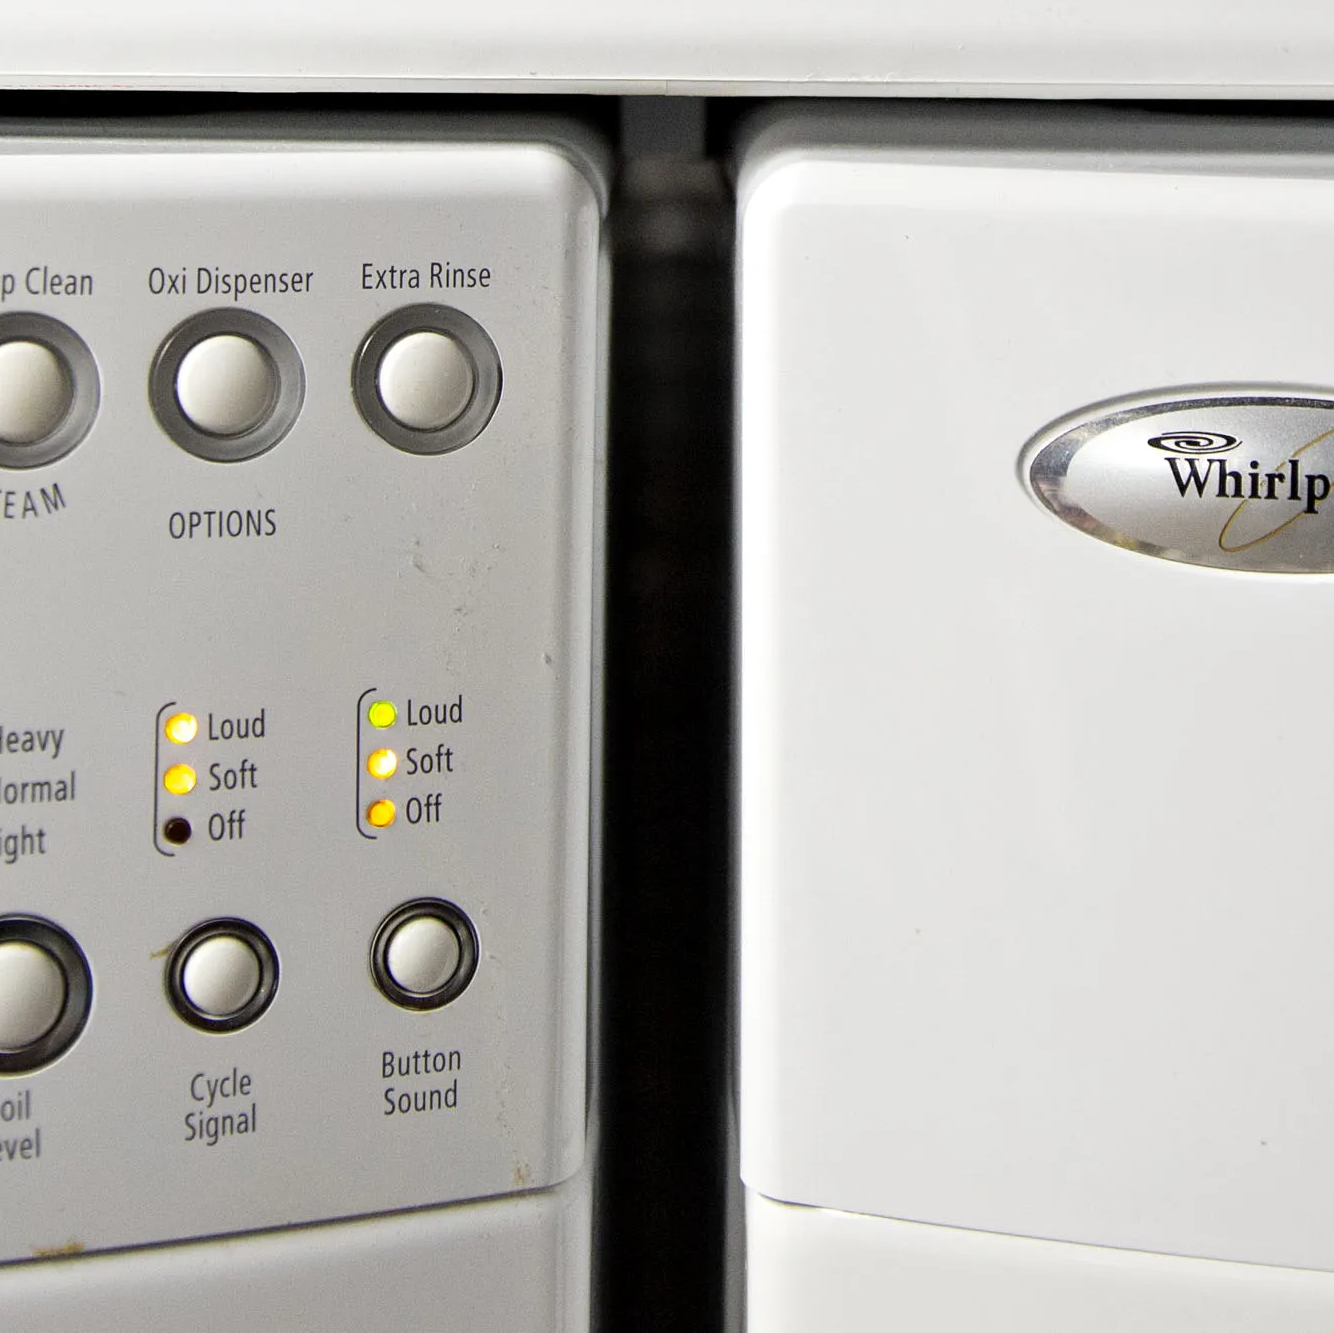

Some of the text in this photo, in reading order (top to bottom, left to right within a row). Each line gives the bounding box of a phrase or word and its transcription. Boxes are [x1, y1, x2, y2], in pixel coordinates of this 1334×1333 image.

[25, 268, 93, 296] Clean
[148, 267, 313, 301] Oxi Dispenser
[362, 262, 491, 290] Extra Rinse
[169, 509, 277, 539] OPTIONS
[208, 709, 266, 741] Loud
[407, 695, 463, 727] Loud
[406, 745, 454, 775] Soft
[208, 760, 258, 792] Soft
[406, 795, 442, 825] Off
[208, 811, 245, 842] Off
[381, 1049, 462, 1079] Button
[190, 1068, 252, 1109] Cycle
[383, 1081, 458, 1116] Sound
[184, 1105, 257, 1146] Signal
